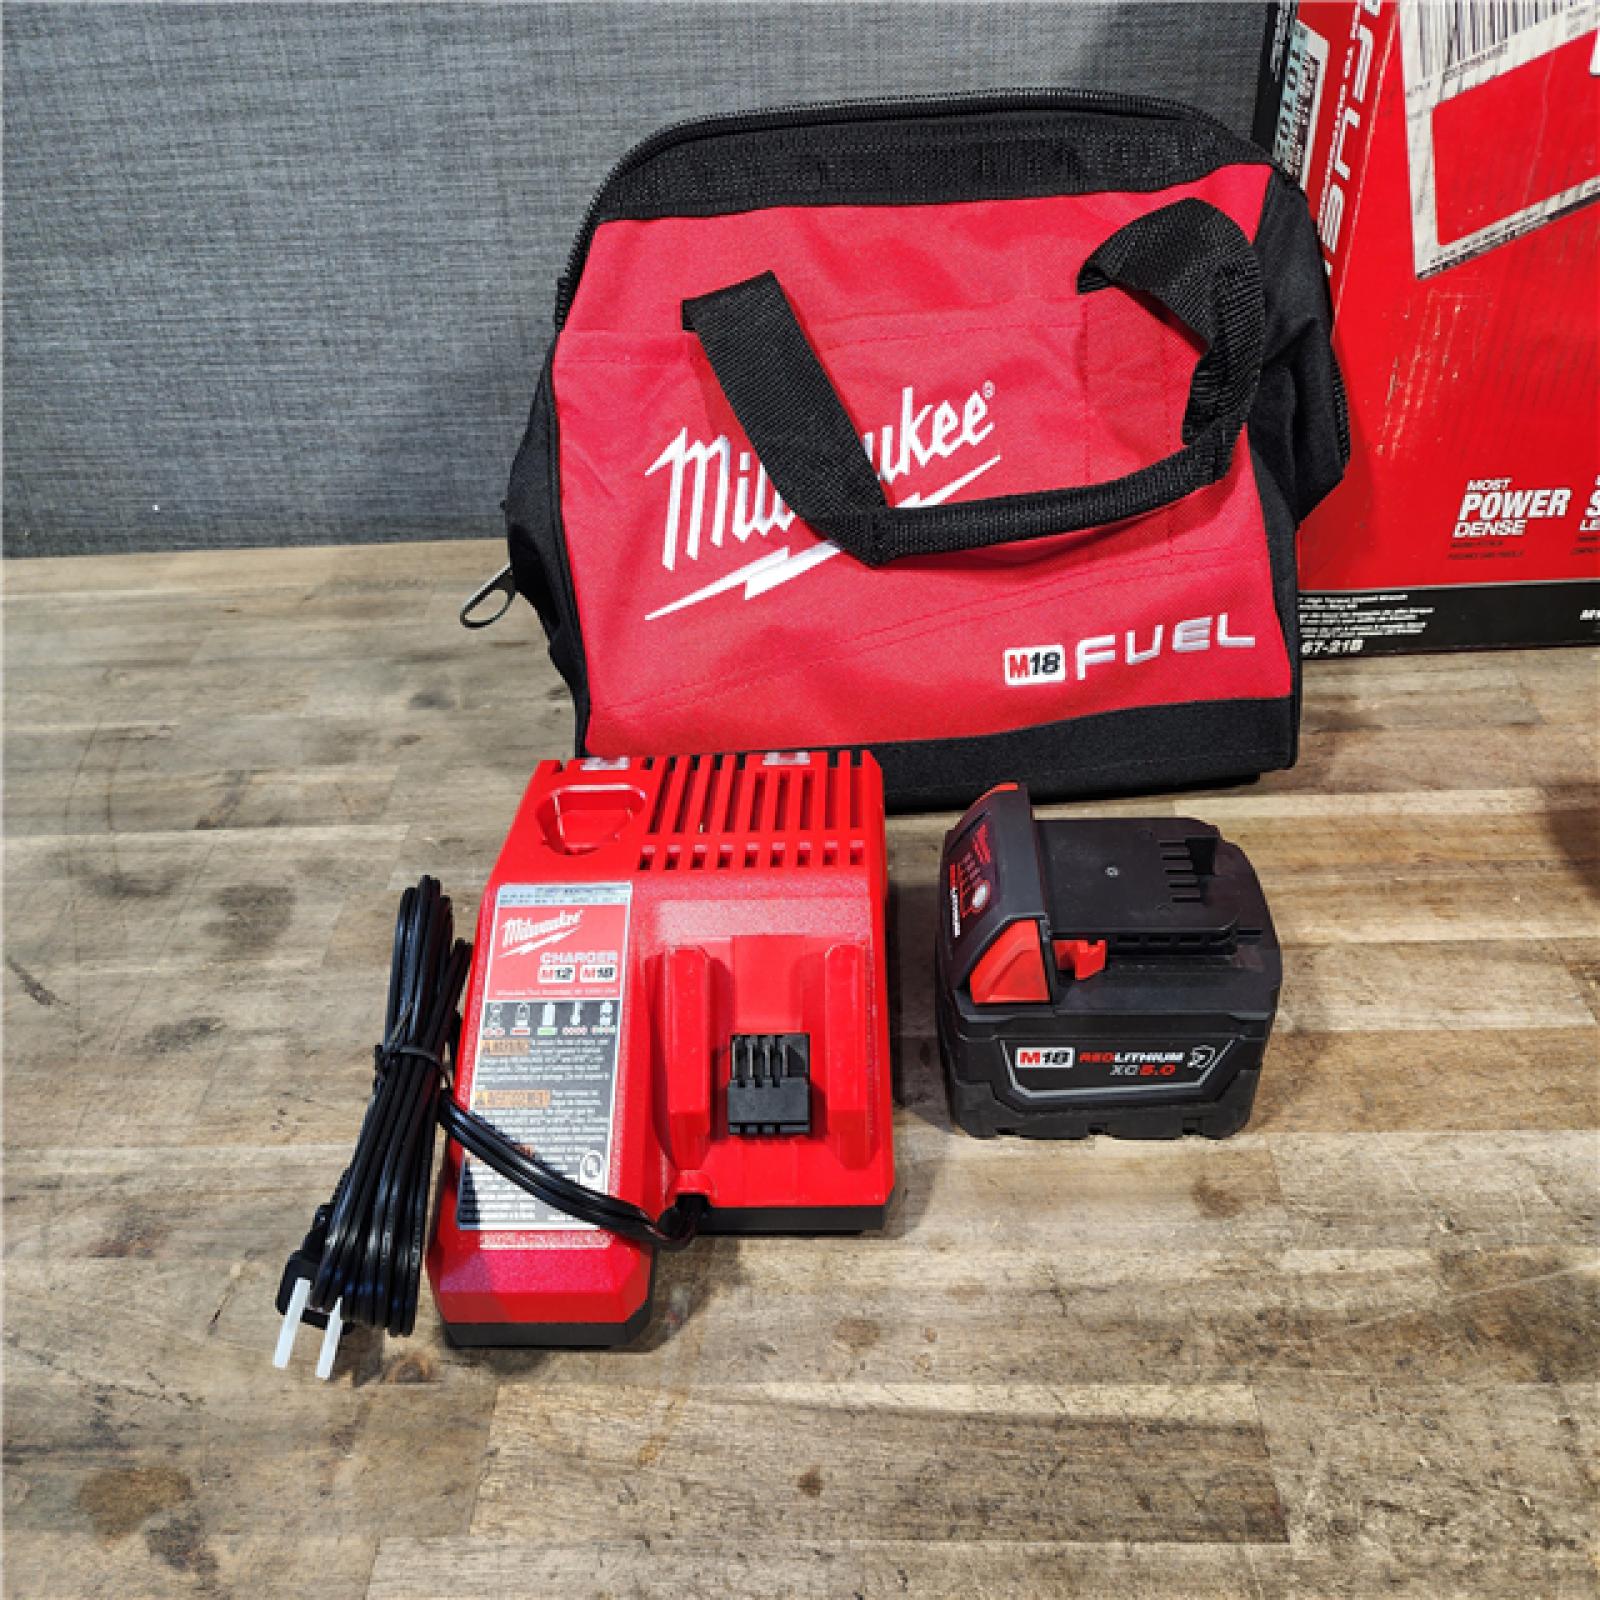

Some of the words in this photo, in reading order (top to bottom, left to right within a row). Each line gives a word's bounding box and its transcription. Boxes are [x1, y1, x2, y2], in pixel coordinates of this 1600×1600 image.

[1322, 24, 1374, 276] FUE
[645, 384, 996, 571] Milukee
[1466, 477, 1512, 491] MOST
[1458, 488, 1572, 520] POWER
[1453, 519, 1528, 538] DENSE
[1008, 651, 1061, 679] M18
[1076, 613, 1257, 681] FUEL
[1019, 1051, 1072, 1067] M18
[1079, 1052, 1185, 1064] REDLITHIUM
